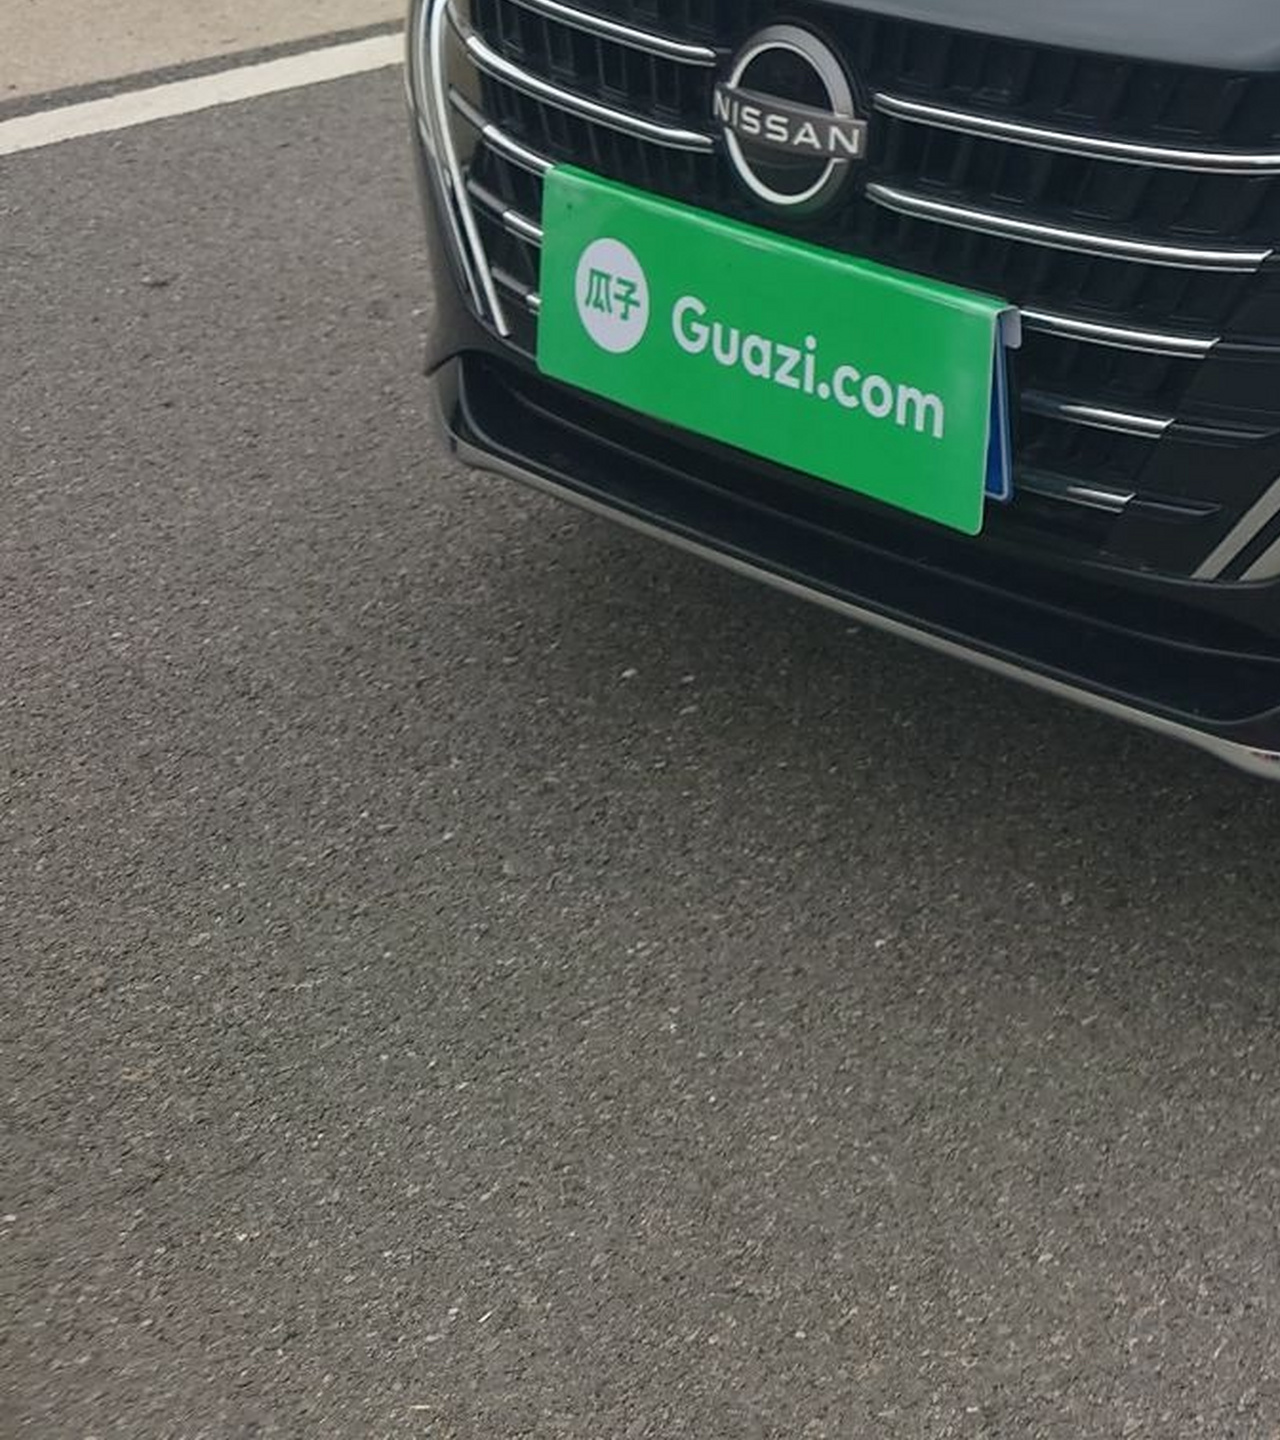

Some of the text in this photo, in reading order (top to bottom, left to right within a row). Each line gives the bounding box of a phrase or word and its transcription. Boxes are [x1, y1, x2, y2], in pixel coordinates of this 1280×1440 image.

[713, 89, 860, 154] NISSAN
[585, 267, 641, 321] 瓜子
[671, 295, 945, 439] Guazi.com
